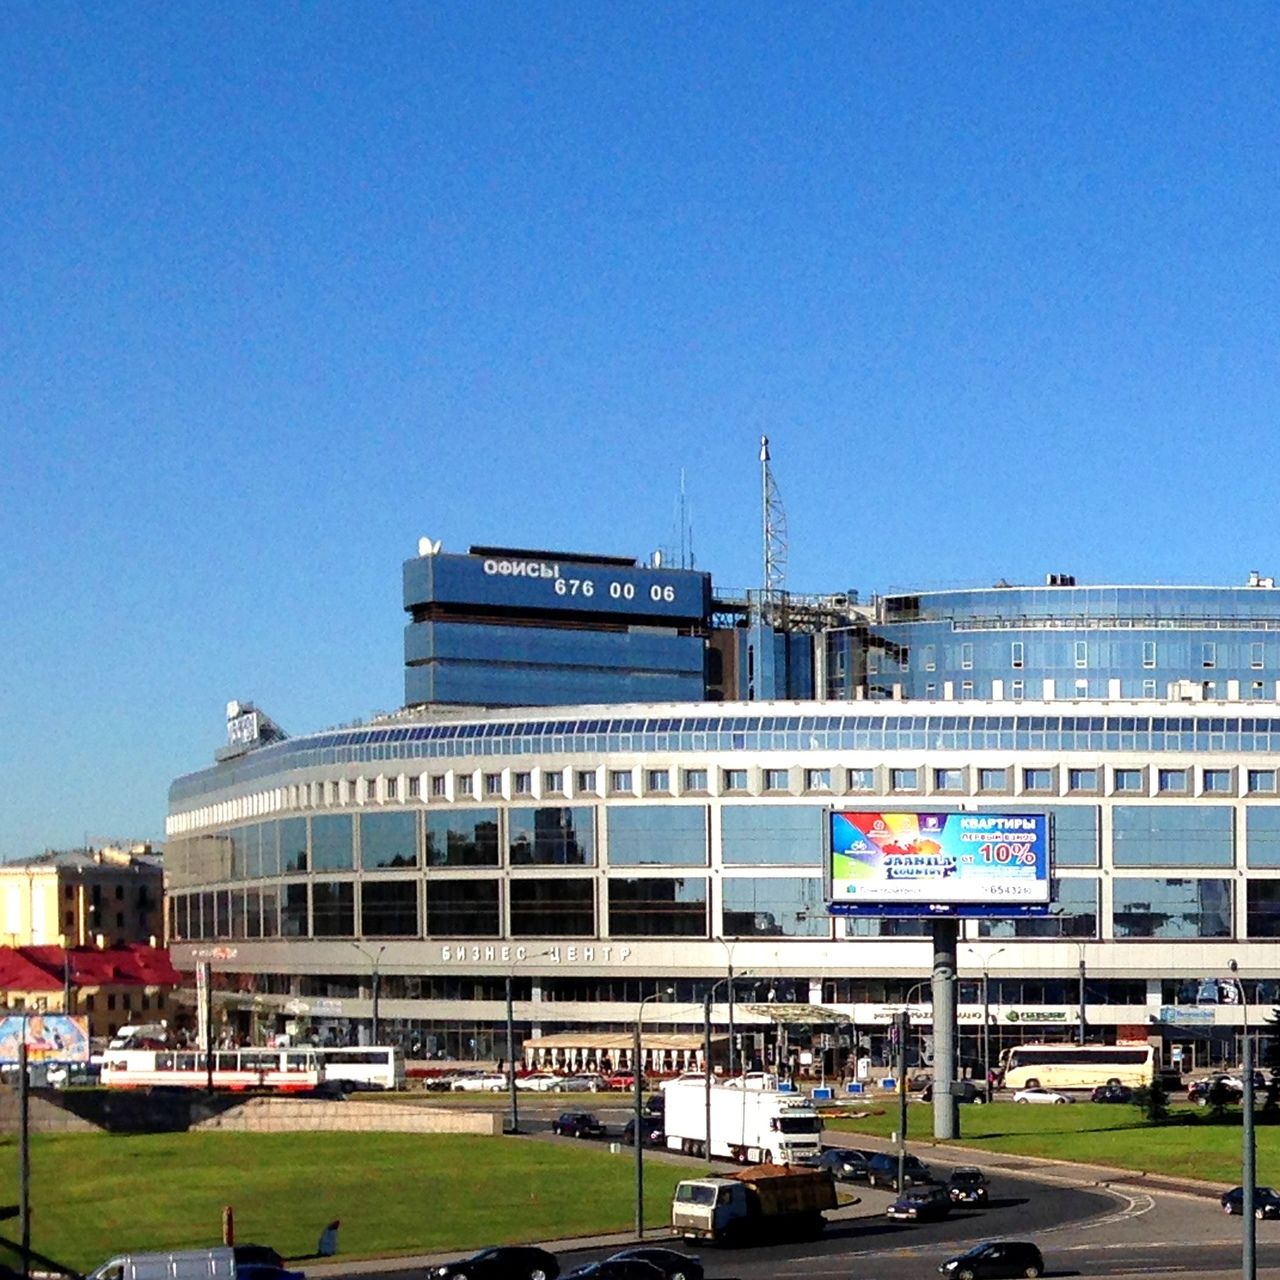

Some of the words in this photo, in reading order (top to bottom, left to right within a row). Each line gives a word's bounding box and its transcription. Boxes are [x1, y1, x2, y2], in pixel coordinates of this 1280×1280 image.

[483, 560, 559, 578] ОФИСЫ
[554, 579, 594, 597] 676
[609, 582, 635, 599] 00
[650, 585, 675, 602] 06
[961, 818, 1036, 829] КВАРТИРЫ
[980, 843, 1036, 864] 10%
[442, 946, 528, 961] БИЗНЕС
[549, 946, 632, 963] ЦЕНТР
